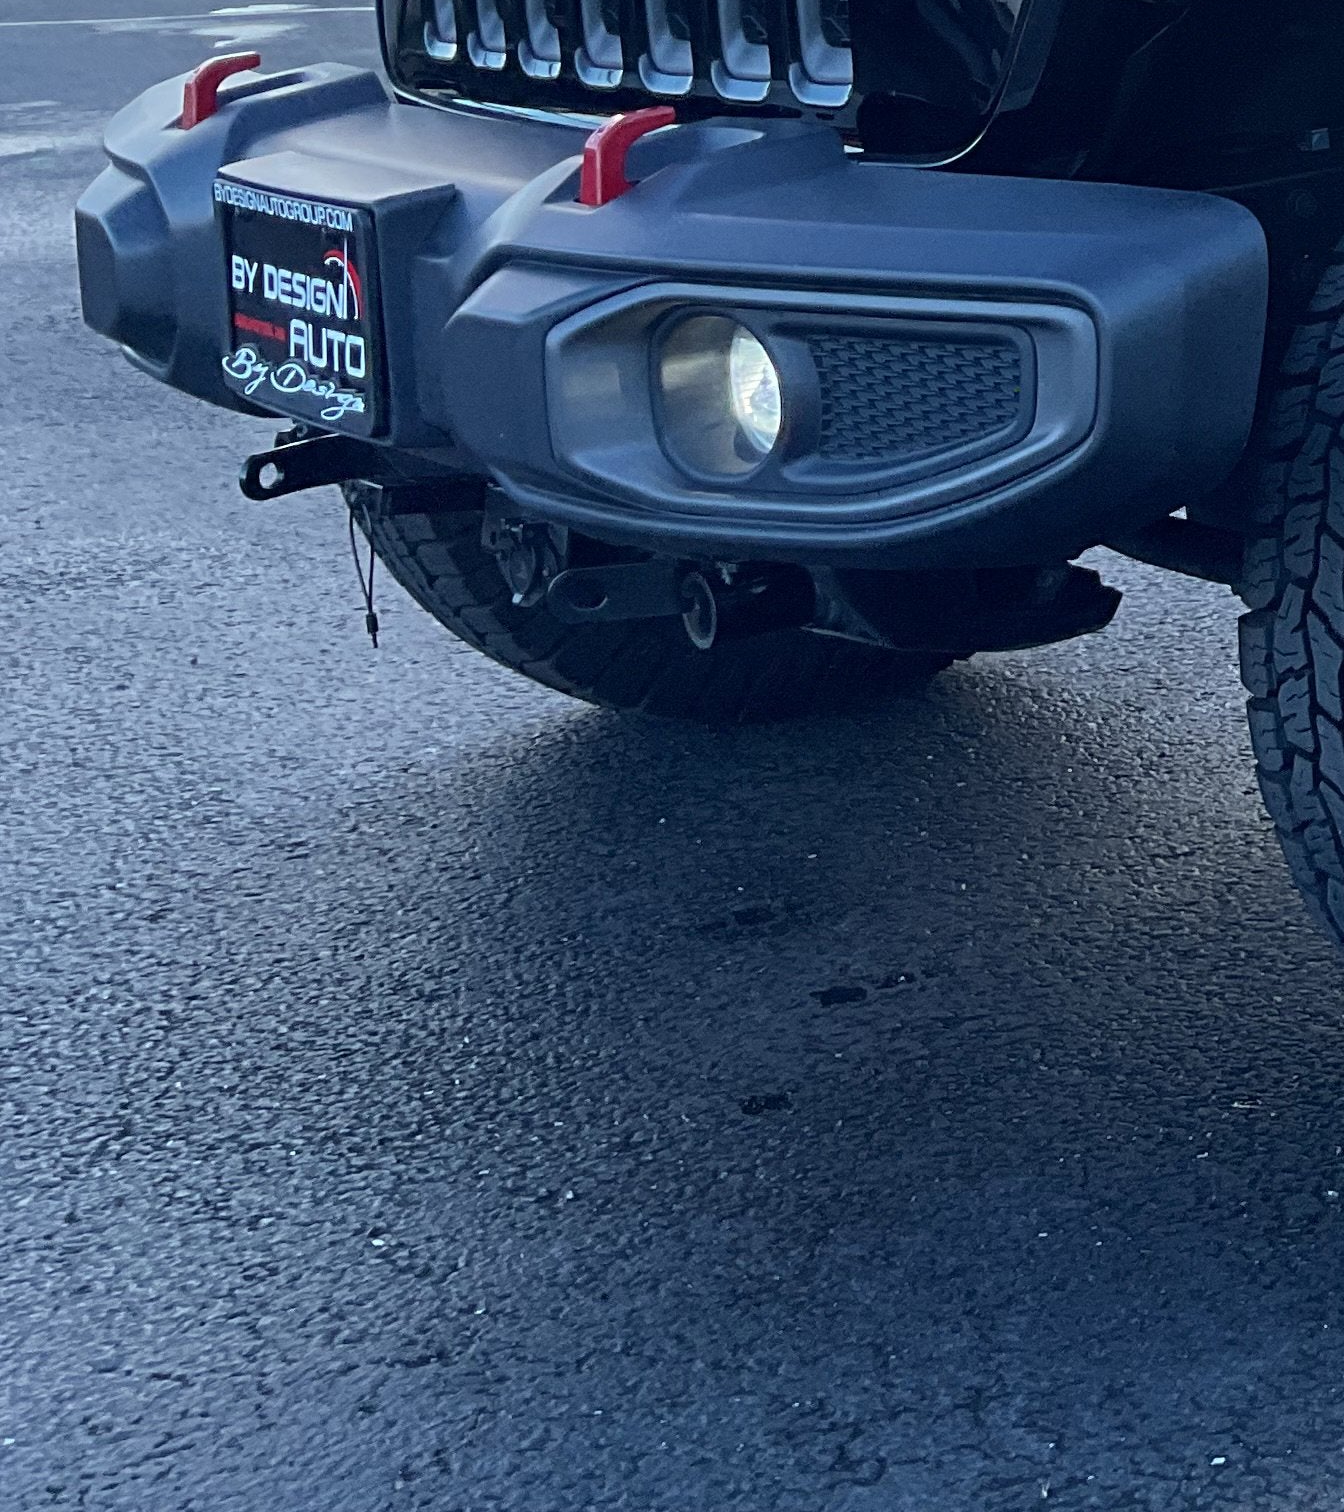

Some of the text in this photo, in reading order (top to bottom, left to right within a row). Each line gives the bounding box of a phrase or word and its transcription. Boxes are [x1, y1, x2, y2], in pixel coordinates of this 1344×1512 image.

[213, 182, 354, 232] BYDESIGNAUTOGROUP.COM
[231, 254, 346, 319] BY DESIGN
[222, 348, 269, 395] By
[289, 318, 366, 378] AUTO
